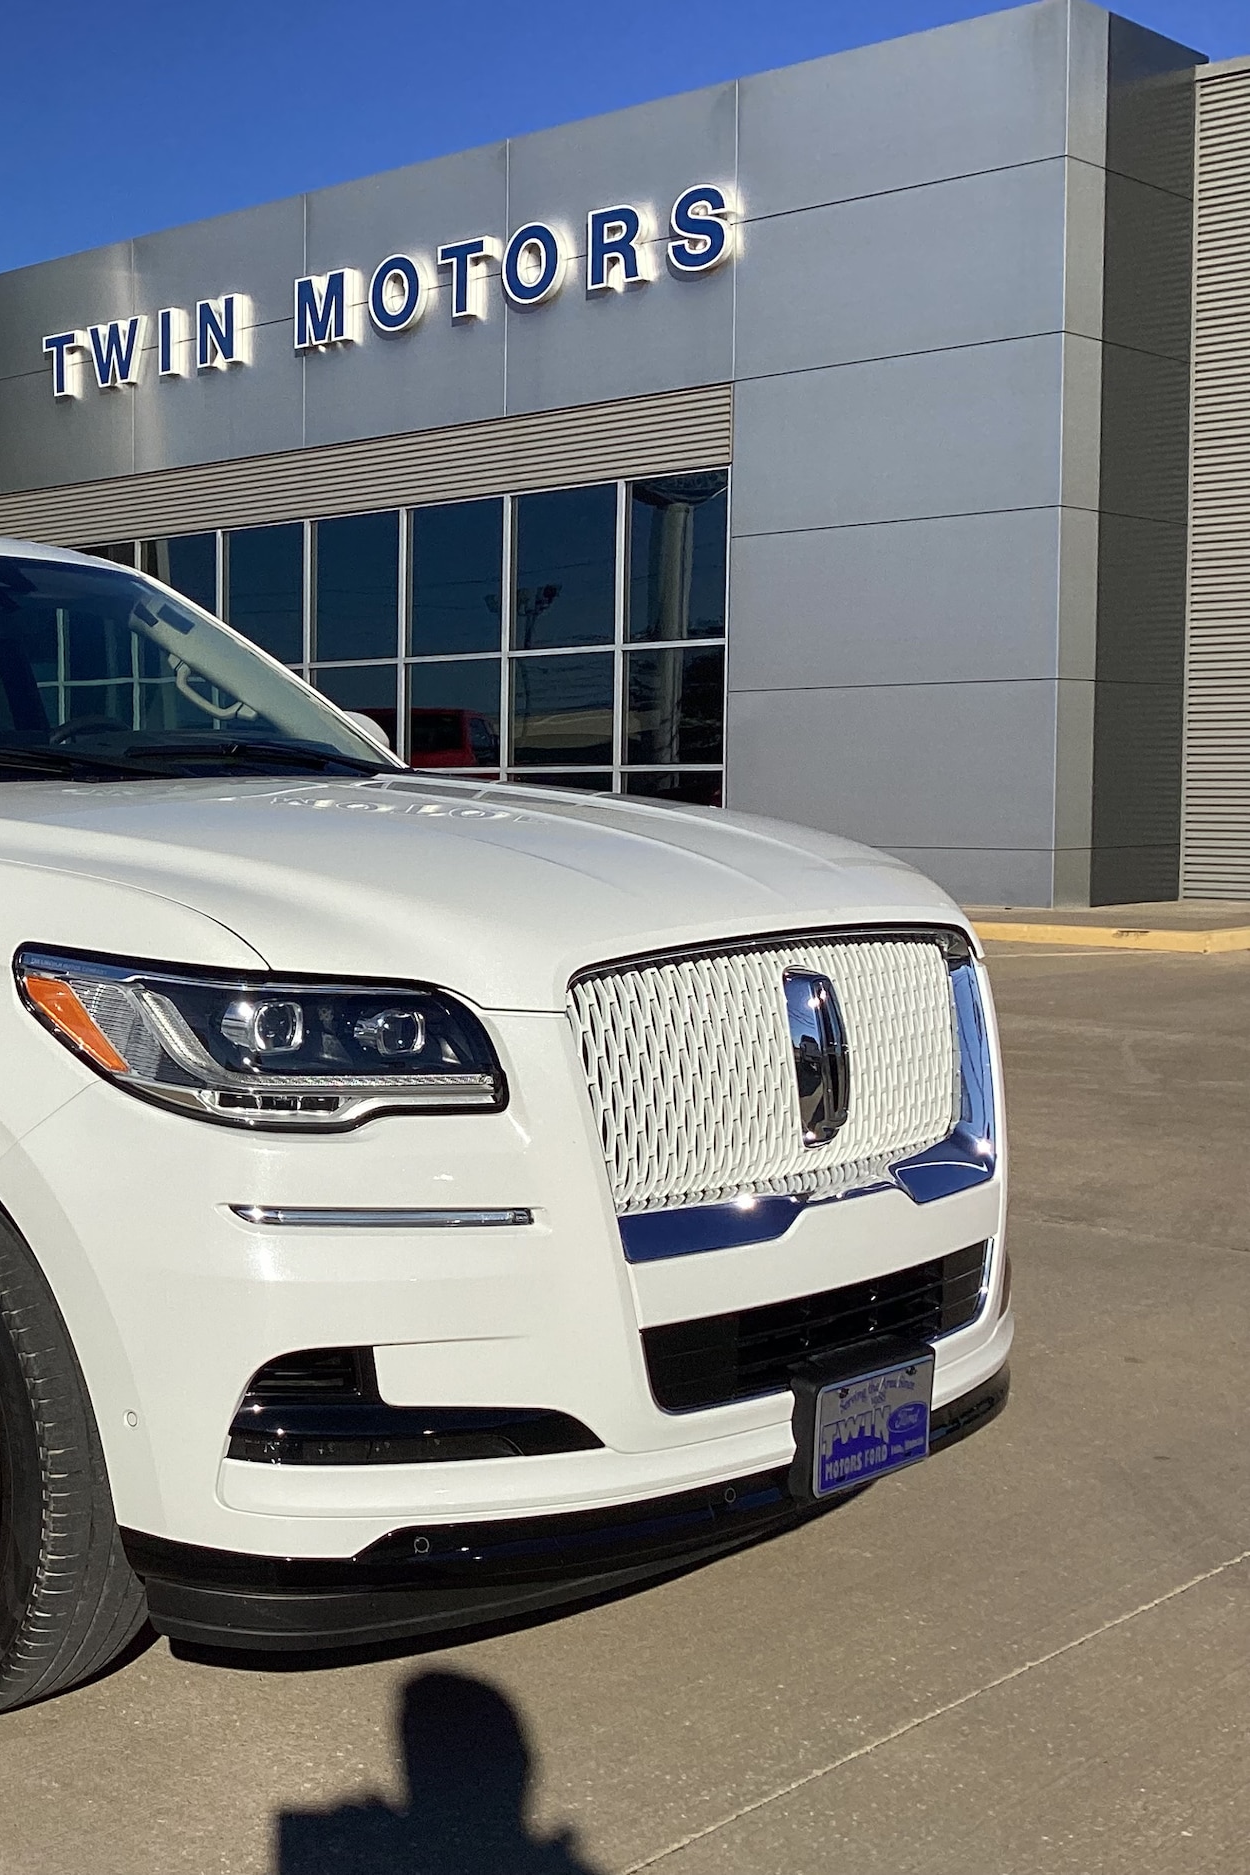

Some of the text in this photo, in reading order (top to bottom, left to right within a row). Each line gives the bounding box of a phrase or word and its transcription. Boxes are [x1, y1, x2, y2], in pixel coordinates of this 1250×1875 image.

[43, 183, 732, 398] TWIN MOTORS
[821, 1404, 891, 1460] TWIN
[825, 1451, 863, 1481] MOTORS
[864, 1443, 888, 1468] FORD
